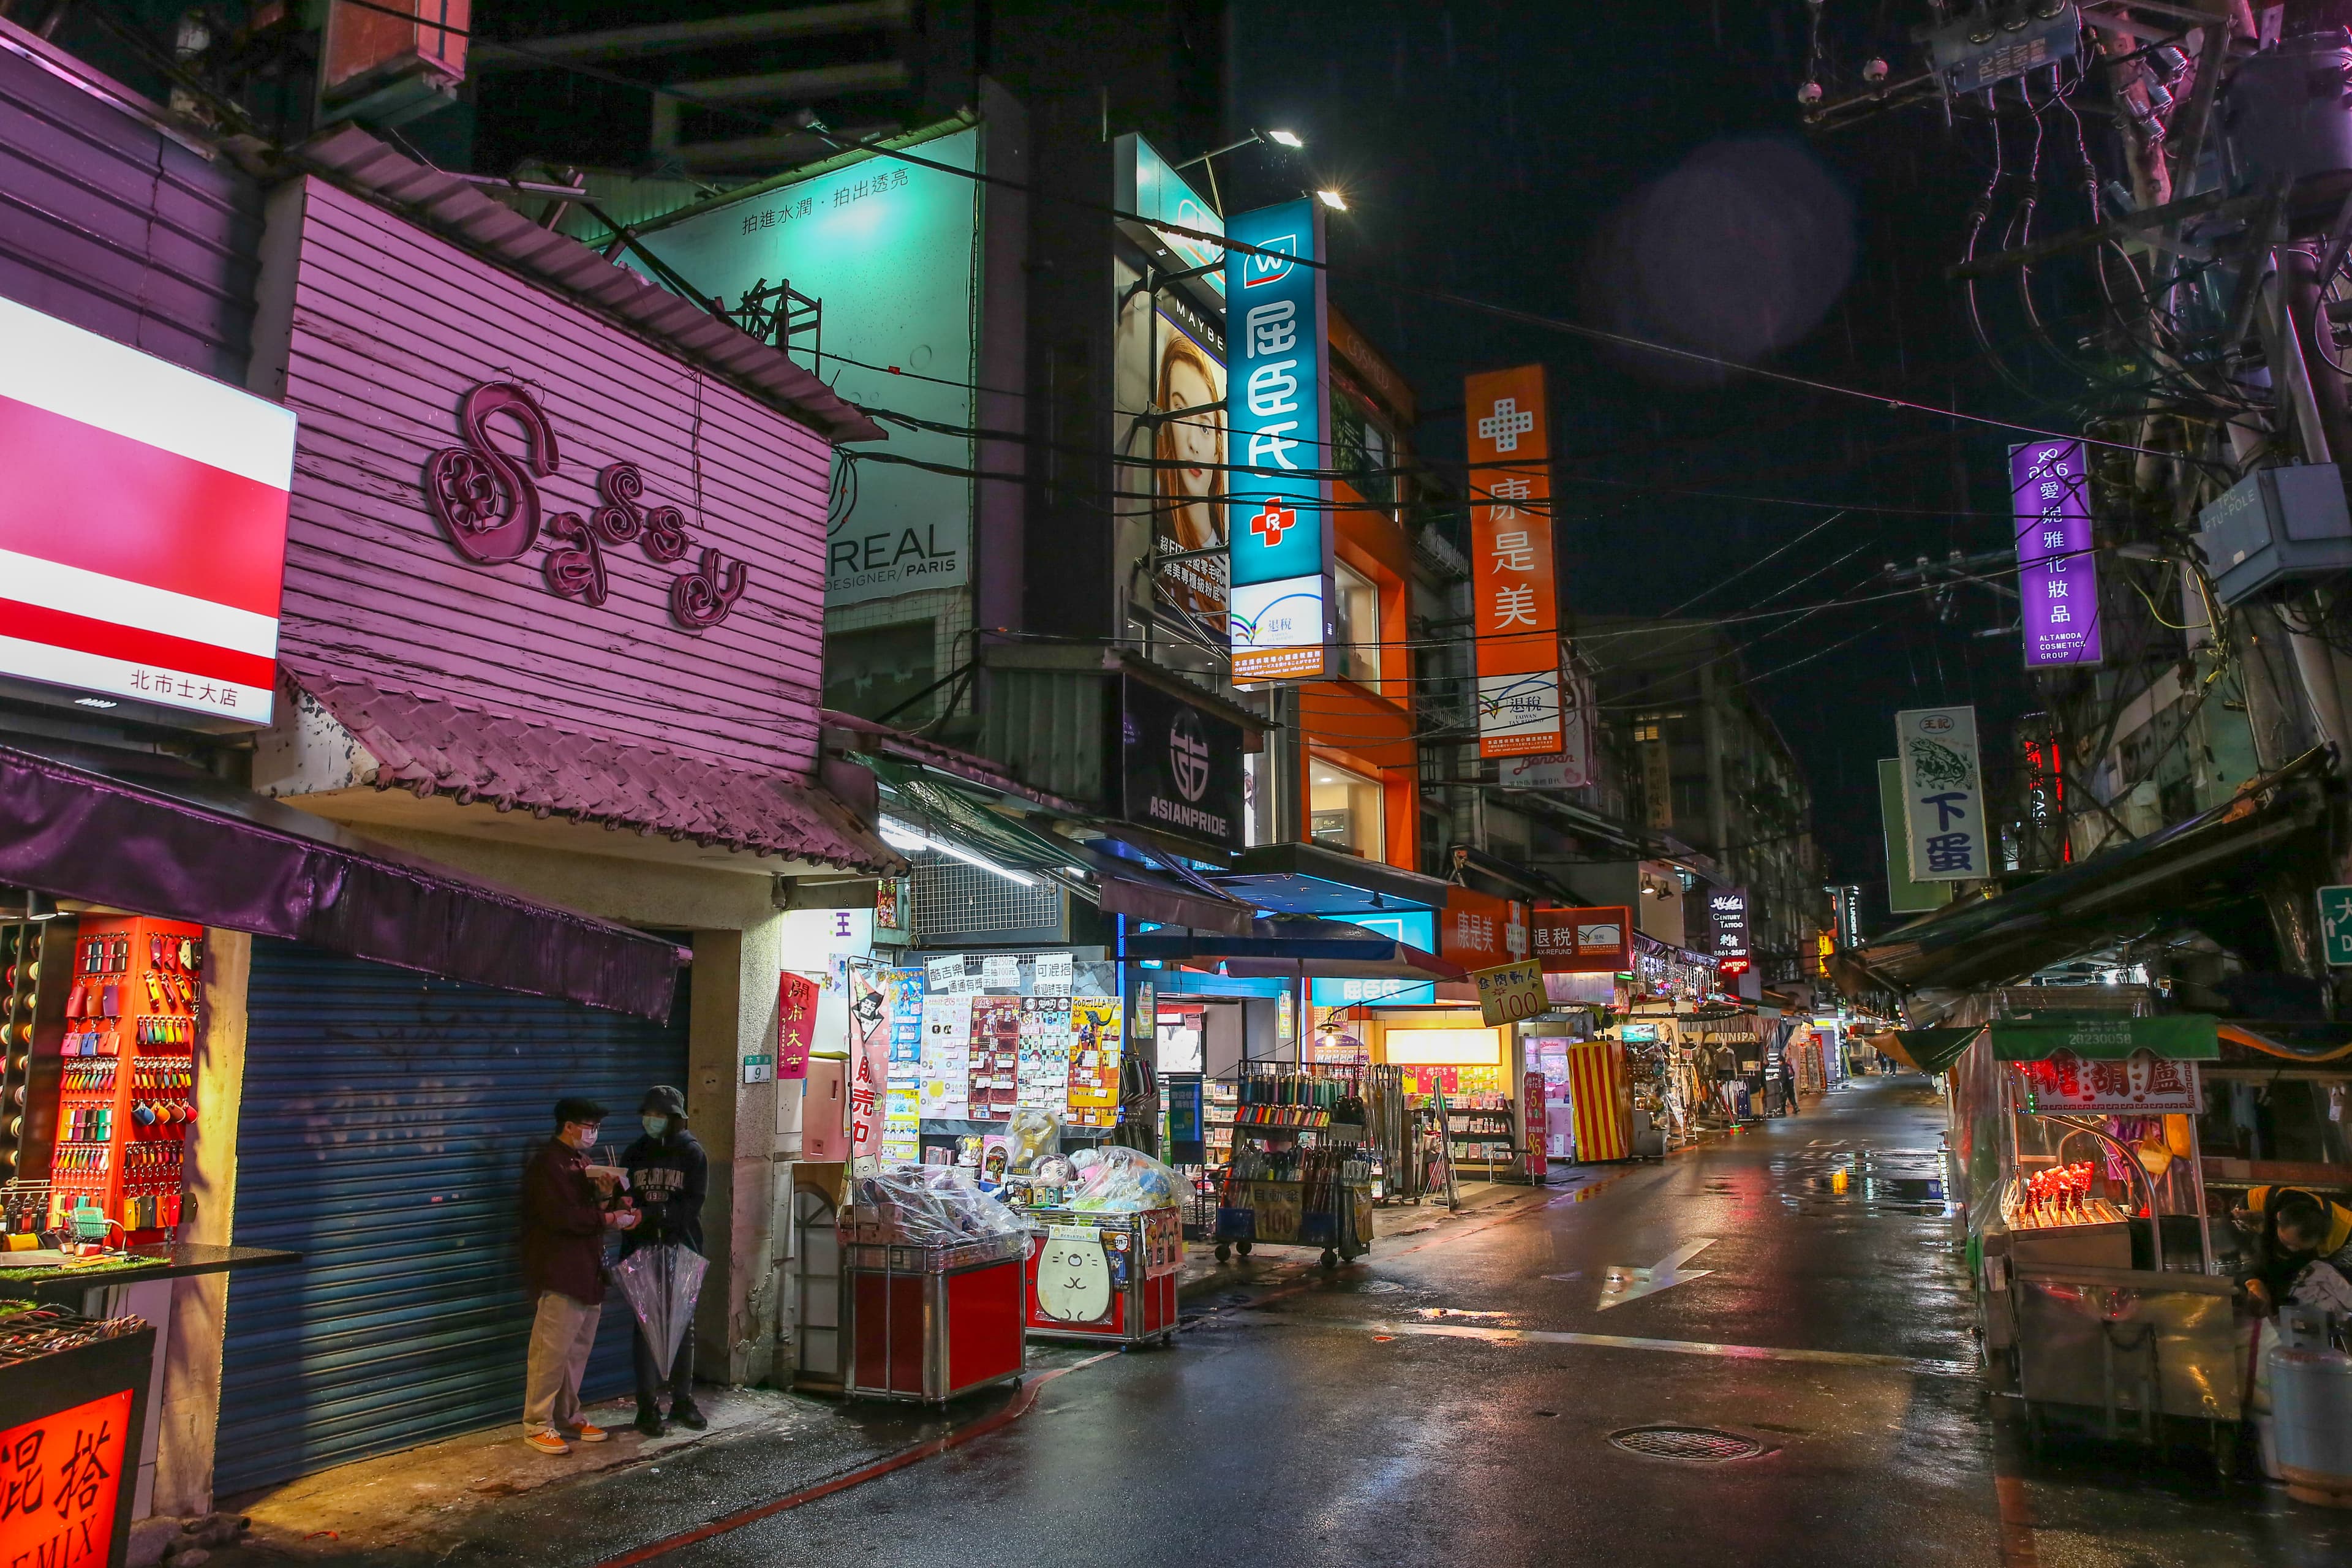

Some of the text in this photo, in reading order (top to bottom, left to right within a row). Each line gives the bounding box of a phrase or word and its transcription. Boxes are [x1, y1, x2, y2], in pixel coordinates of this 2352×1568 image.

[1246, 300, 1299, 479] 屈臣氏
[2217, 488, 2237, 510] TPC
[2204, 489, 2256, 533] FTU-POLE
[1489, 478, 1537, 630] 康是美
[2038, 632, 2082, 642] ALTAMODA
[2039, 640, 2087, 651] COSMETICS
[2040, 651, 2069, 660] GROUP
[130, 669, 238, 709] 北市士大店
[1923, 718, 1951, 729] 王記
[1150, 796, 1227, 837] ASIANPRIDE
[1920, 791, 1973, 872] 下蛋
[835, 912, 851, 937] 王
[1849, 906, 1858, 934] UNDER
[1457, 910, 1494, 953] 康是美
[929, 963, 963, 982] 酷吉樂
[983, 957, 1016, 967] 一抽250元
[983, 968, 1016, 976] 三抽700元
[1037, 963, 1071, 978] 可混搭
[948, 977, 984, 993] 通通有獎
[983, 978, 1019, 987] 五抽1000元
[1033, 982, 1071, 995] 歡迎試手氣
[1343, 979, 1400, 1000] 屈臣氏
[1073, 998, 1106, 1008] GODZILLA
[1494, 991, 1539, 1020] 100
[786, 979, 810, 1072] 開市大吉
[754, 1067, 761, 1080] 9
[1254, 1189, 1299, 1204] 自動傘
[1264, 1209, 1294, 1235] 100
[0, 1420, 111, 1521] 混搭
